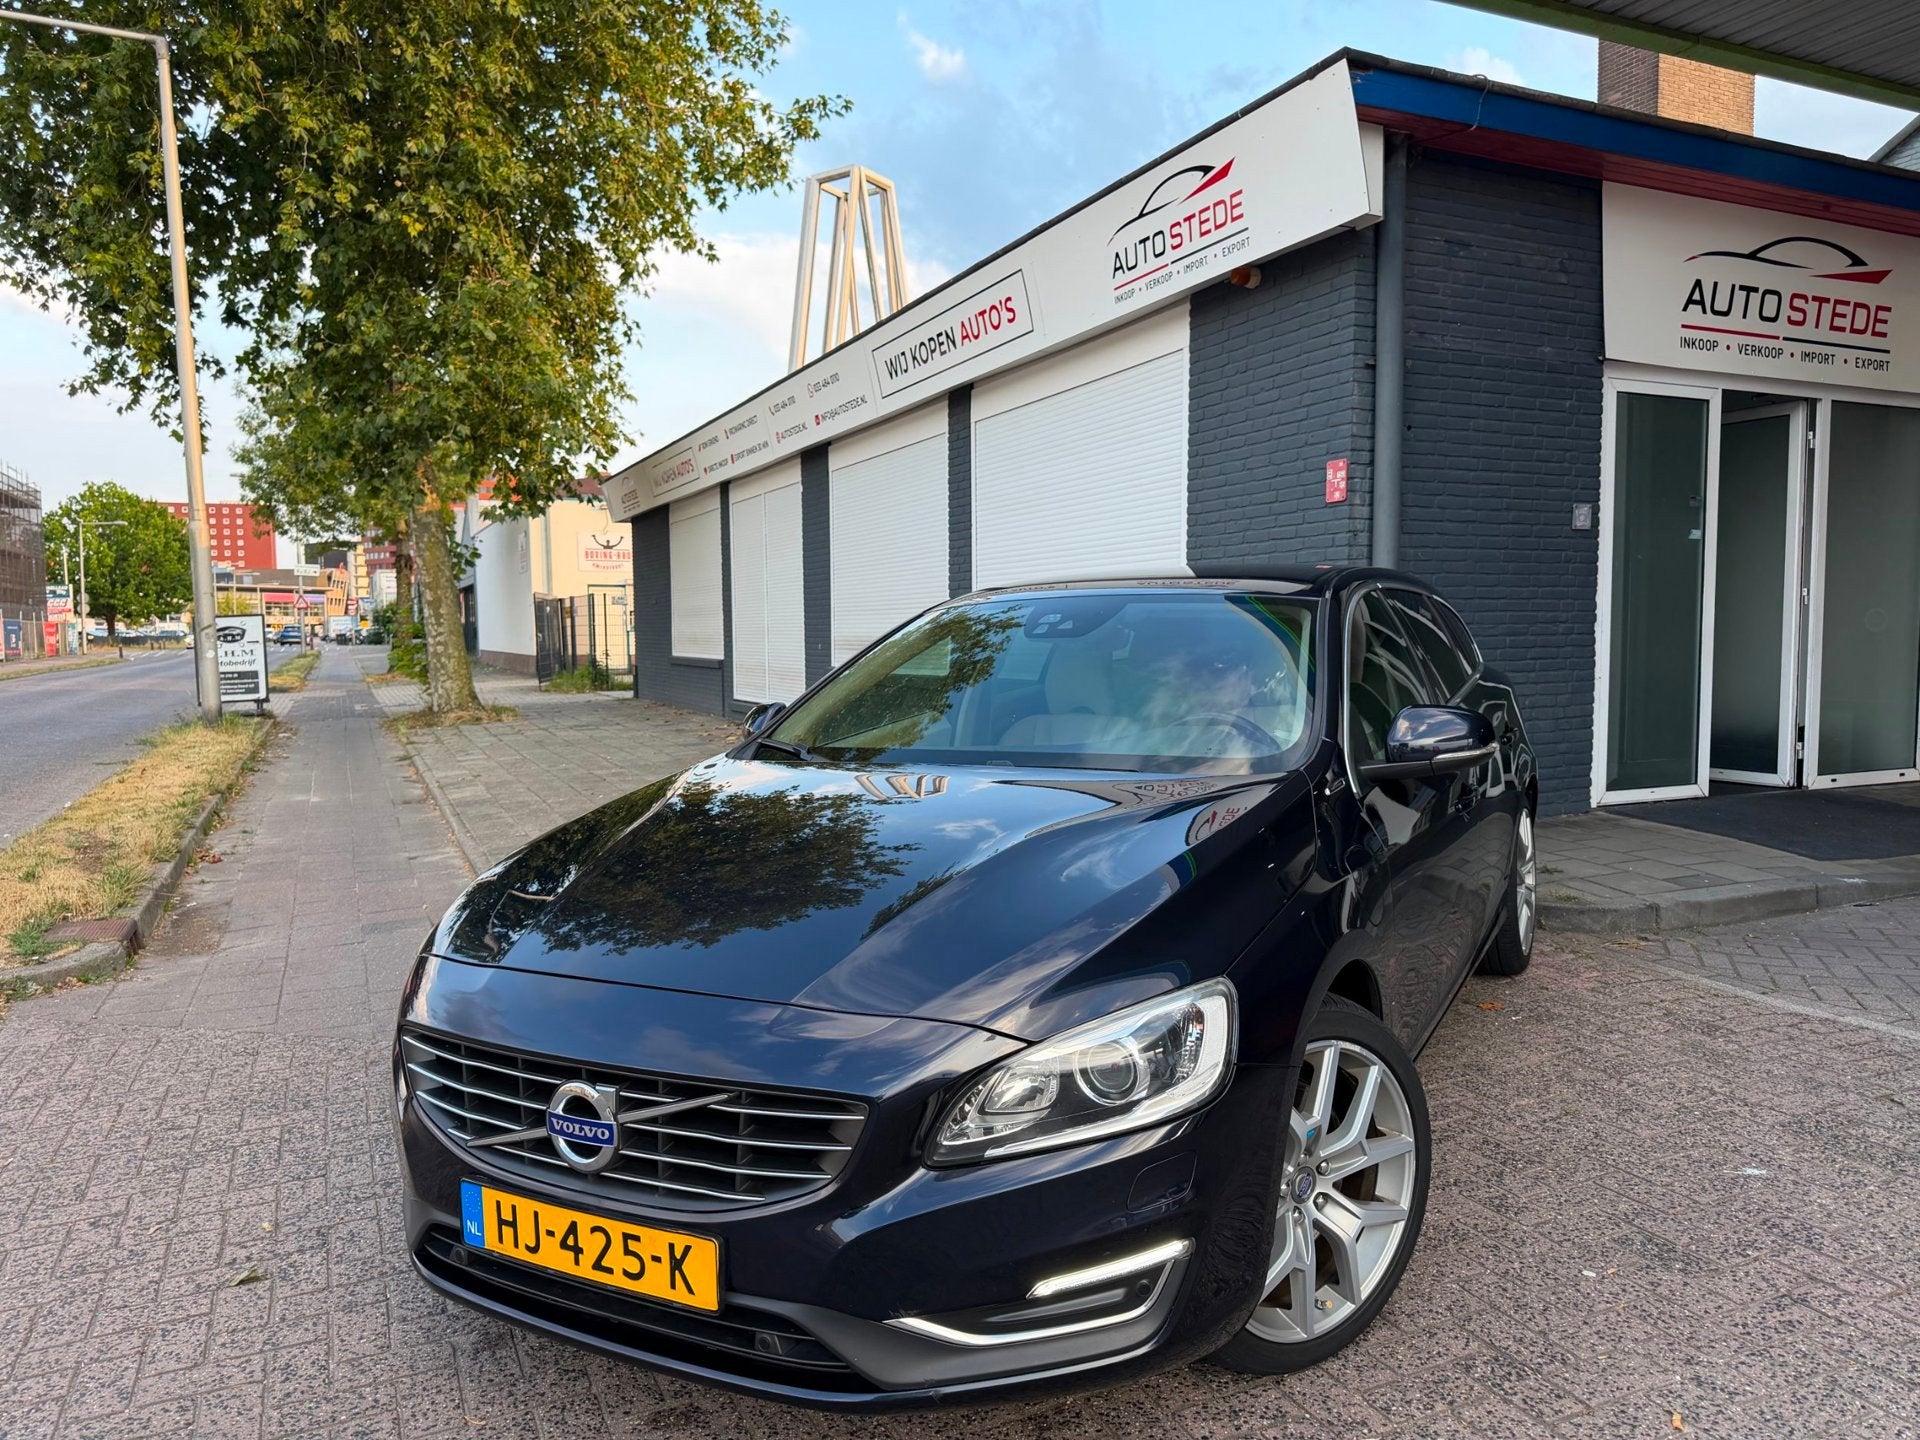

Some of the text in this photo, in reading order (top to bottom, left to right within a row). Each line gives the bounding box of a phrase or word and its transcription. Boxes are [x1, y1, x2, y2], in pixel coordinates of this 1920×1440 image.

[1112, 189, 1245, 279] AUTOSTEDE
[1114, 236, 1251, 304] INKOOP VERKOOP IMPORT EXPORT
[885, 296, 1017, 380] WIJ KOPEN AUTO'S
[1681, 278, 1892, 338] AUTOSTEDE
[1680, 336, 1891, 373] INKOOP VERKOOP IMPORT EXPORT
[551, 1117, 610, 1140] VOLVO
[466, 1219, 482, 1236] NL
[495, 1199, 696, 1296] HJ-425-K
